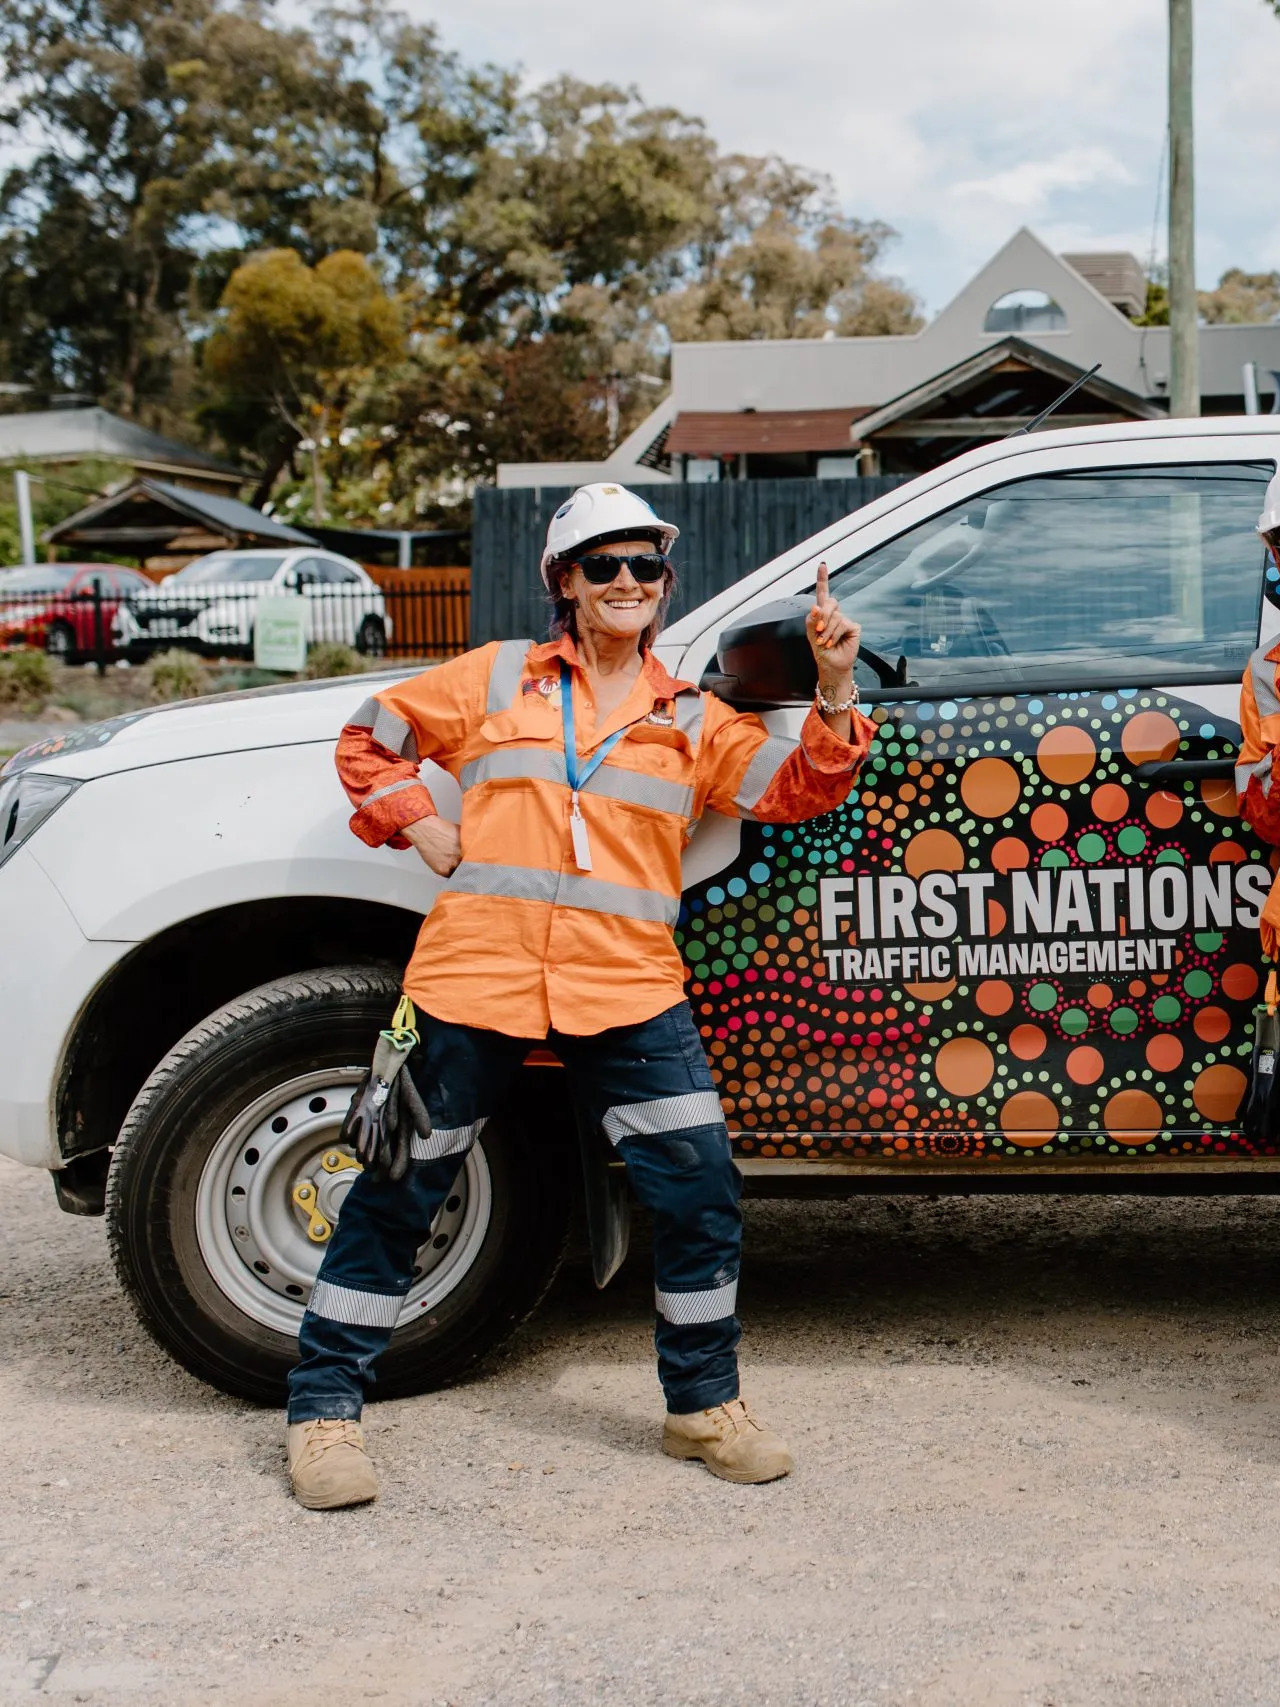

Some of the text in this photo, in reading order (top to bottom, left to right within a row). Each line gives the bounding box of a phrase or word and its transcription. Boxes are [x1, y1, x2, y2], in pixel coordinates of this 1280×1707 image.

[820, 864, 1272, 941] FIRST NATIONS
[823, 938, 1177, 981] TRAFFIC MANAGEMENT
